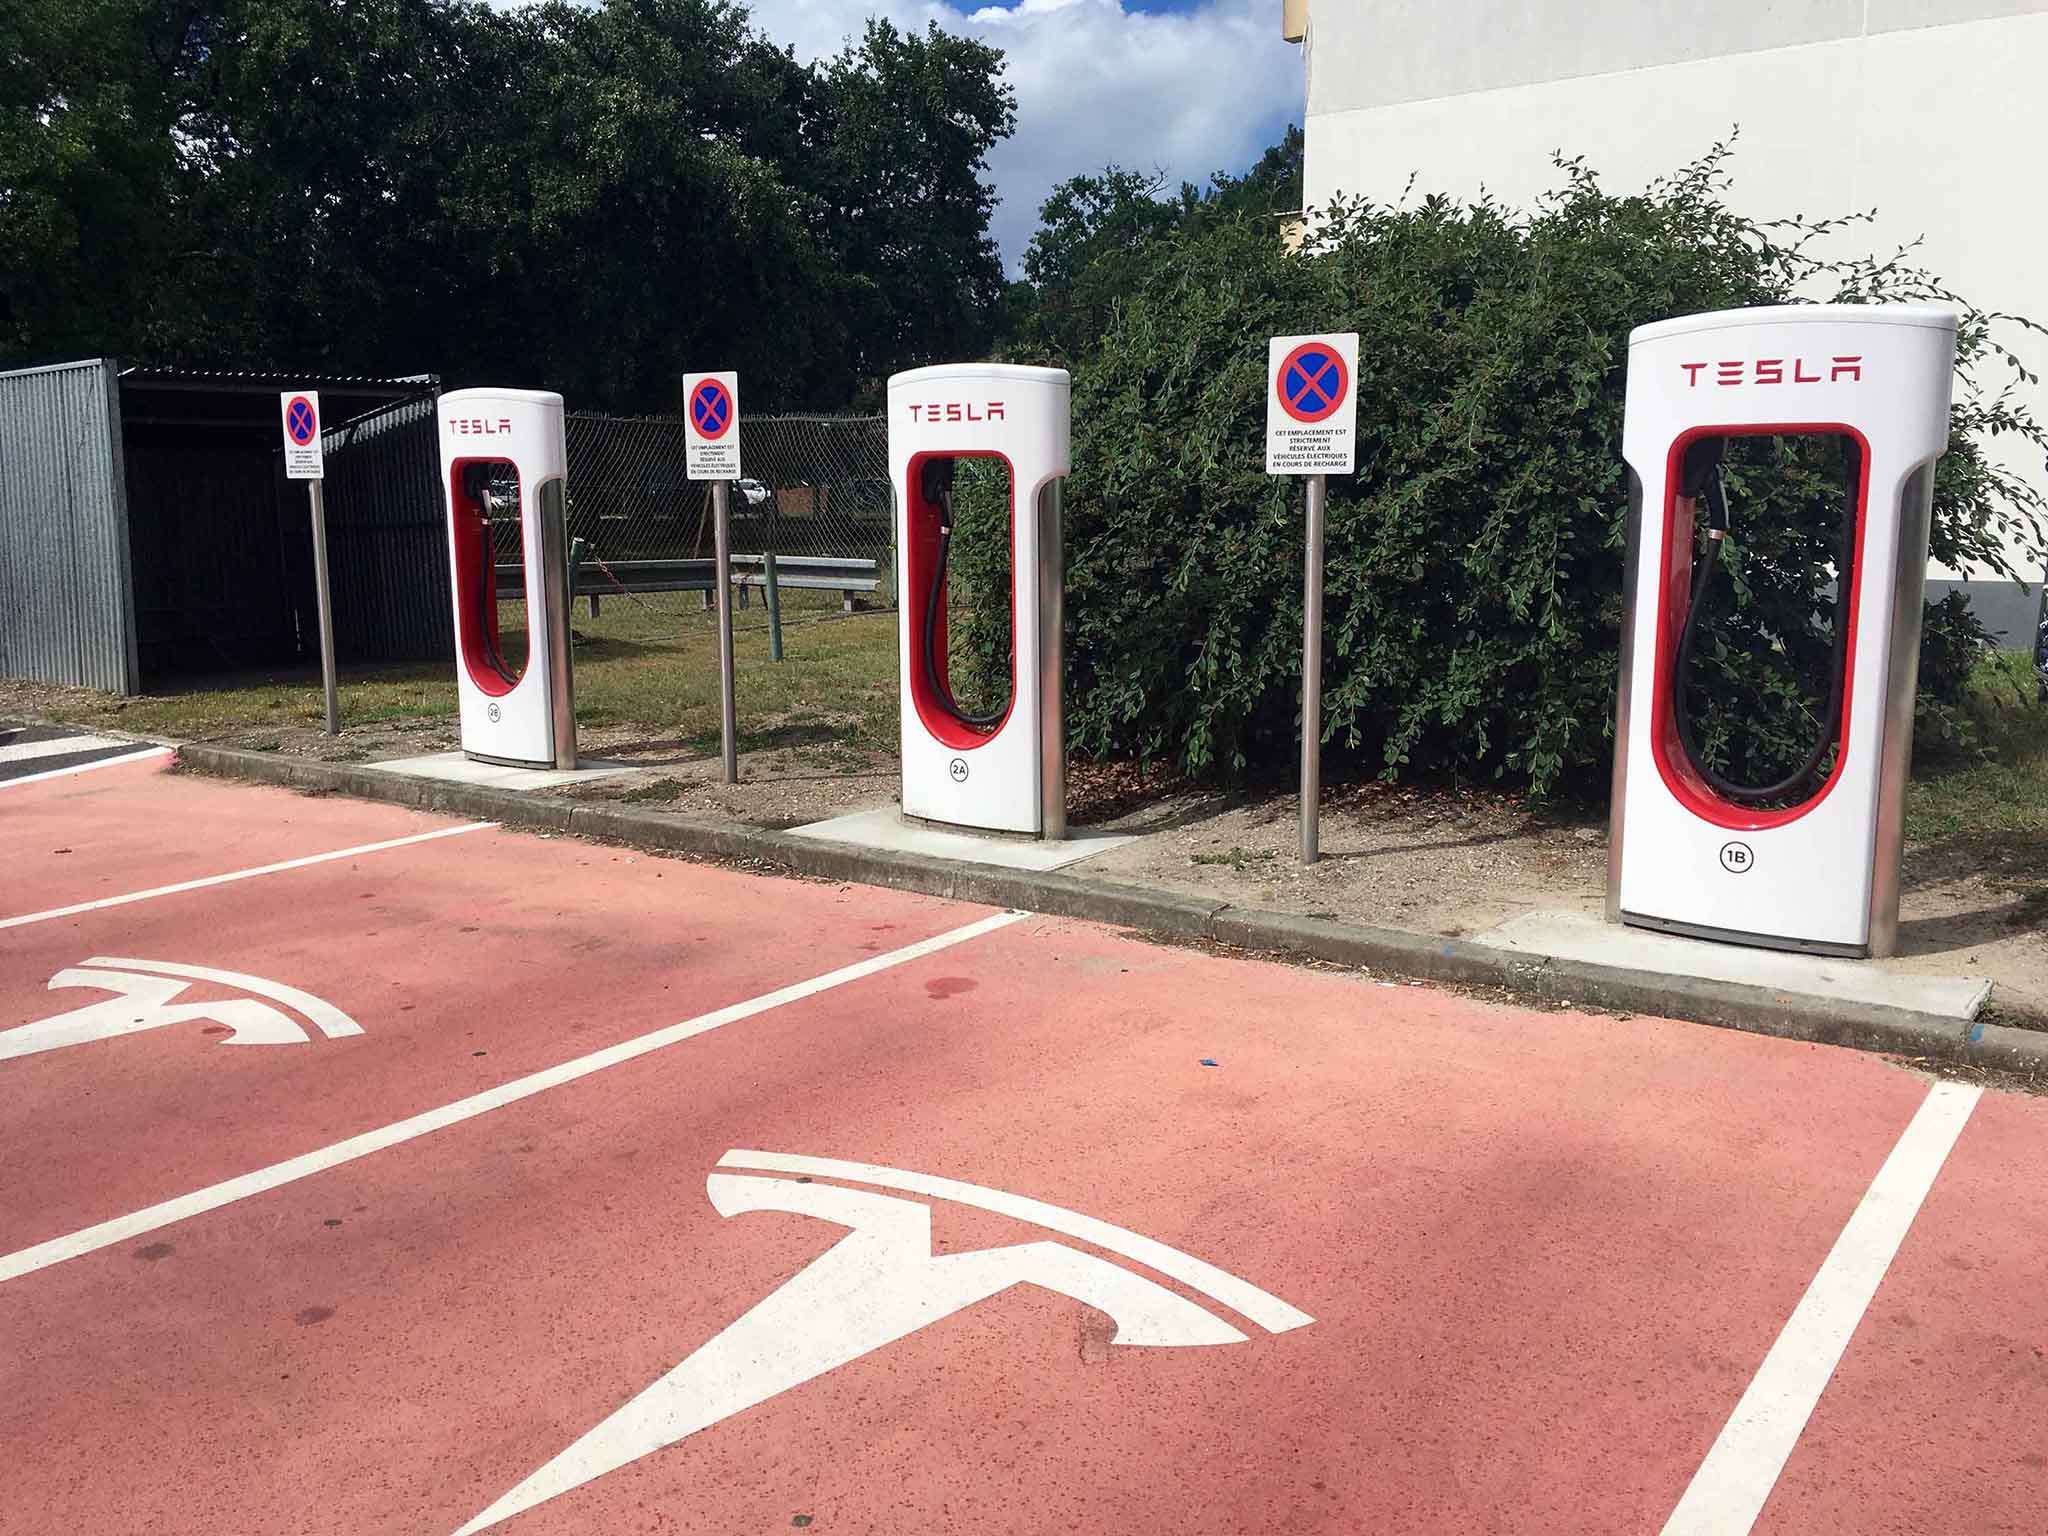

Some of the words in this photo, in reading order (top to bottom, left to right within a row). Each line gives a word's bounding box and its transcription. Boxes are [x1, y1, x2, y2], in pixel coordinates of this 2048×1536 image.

[1680, 356, 1862, 387] TESLA
[909, 402, 1004, 423] TESLA
[449, 419, 511, 434] TESLA
[953, 764, 966, 775] 2A
[1728, 850, 1746, 863] 1B
